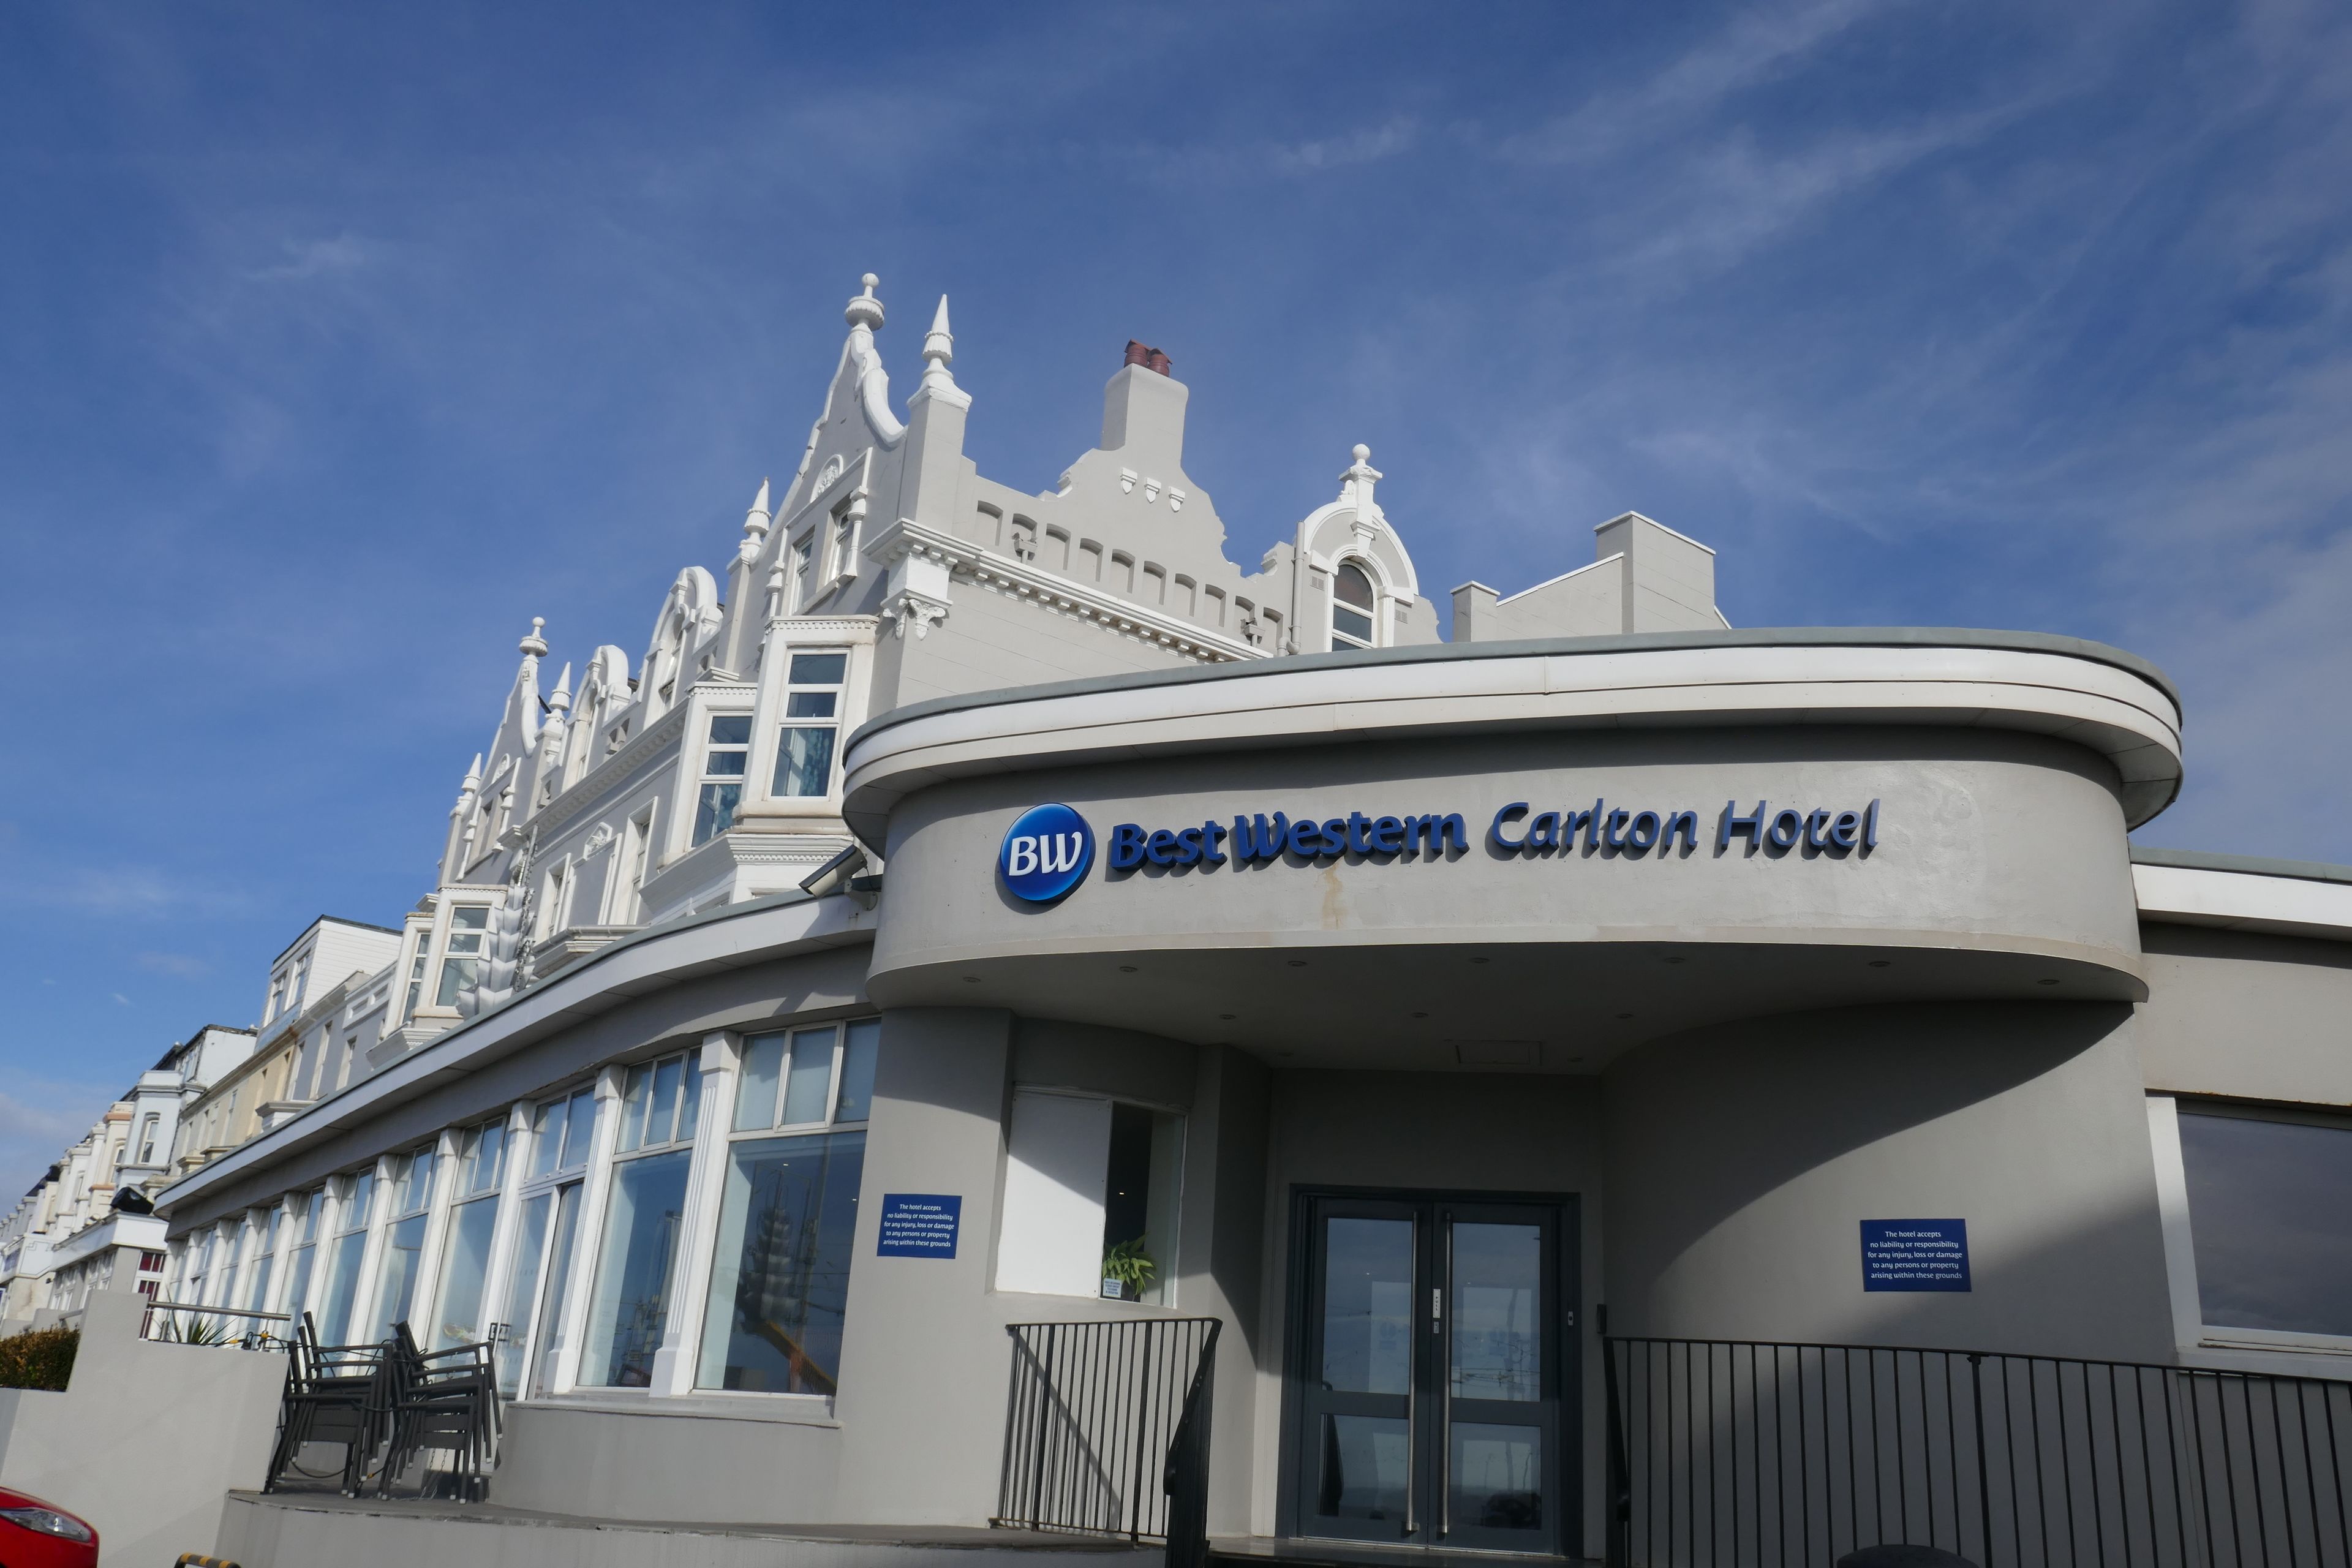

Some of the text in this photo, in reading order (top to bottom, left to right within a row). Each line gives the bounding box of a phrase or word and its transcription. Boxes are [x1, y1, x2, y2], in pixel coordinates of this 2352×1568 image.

[1009, 831, 1082, 876] BW
[1109, 797, 1880, 871] Best Western Carlton Hotel
